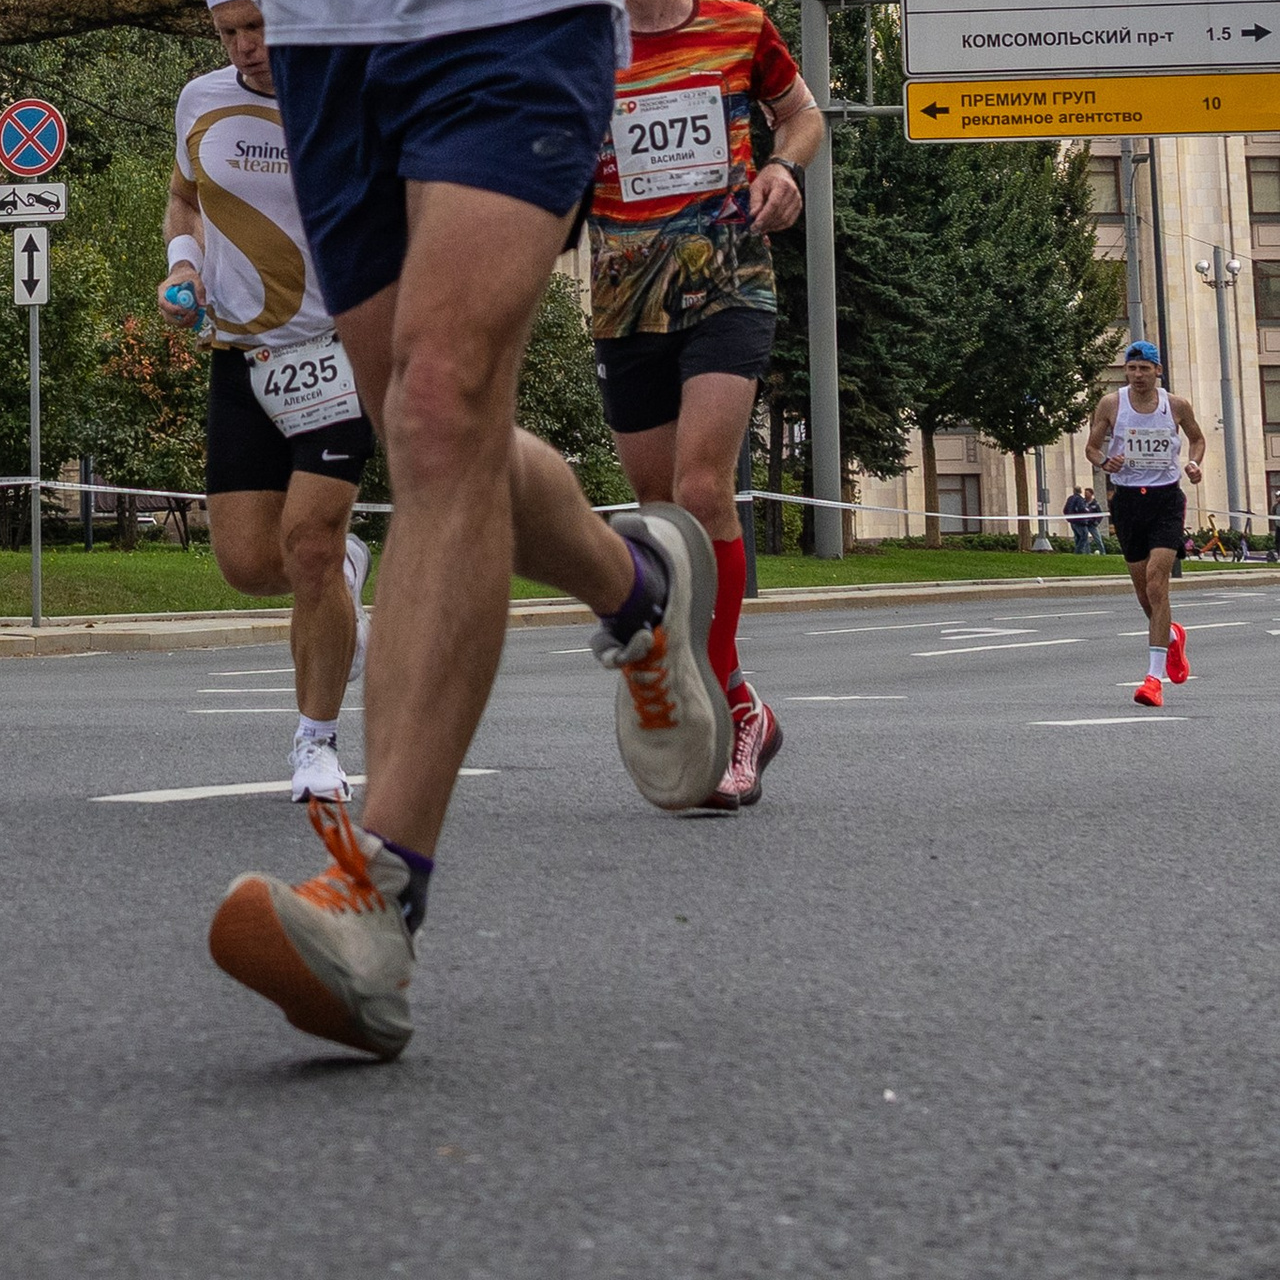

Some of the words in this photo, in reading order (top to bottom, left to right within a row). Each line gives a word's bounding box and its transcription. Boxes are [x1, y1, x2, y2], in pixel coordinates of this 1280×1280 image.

[962, 26, 1132, 49] КОМСОМОЛЬСКИЙ
[1137, 31, 1174, 46] пр-т
[1206, 27, 1232, 41] 1.5
[961, 92, 1047, 107] ПРЕМИУМ
[1052, 91, 1096, 105] ГРУП
[1202, 96, 1221, 110] 10
[962, 113, 1053, 129] рекламное
[1058, 111, 1143, 123] агентство
[628, 114, 711, 155] 2075
[244, 157, 288, 174] team
[650, 149, 695, 165] ВАСИЛИЙ
[264, 354, 338, 397] 4235
[283, 388, 323, 407] АЛЕКСЕЙ
[1127, 439, 1169, 452] 11129
